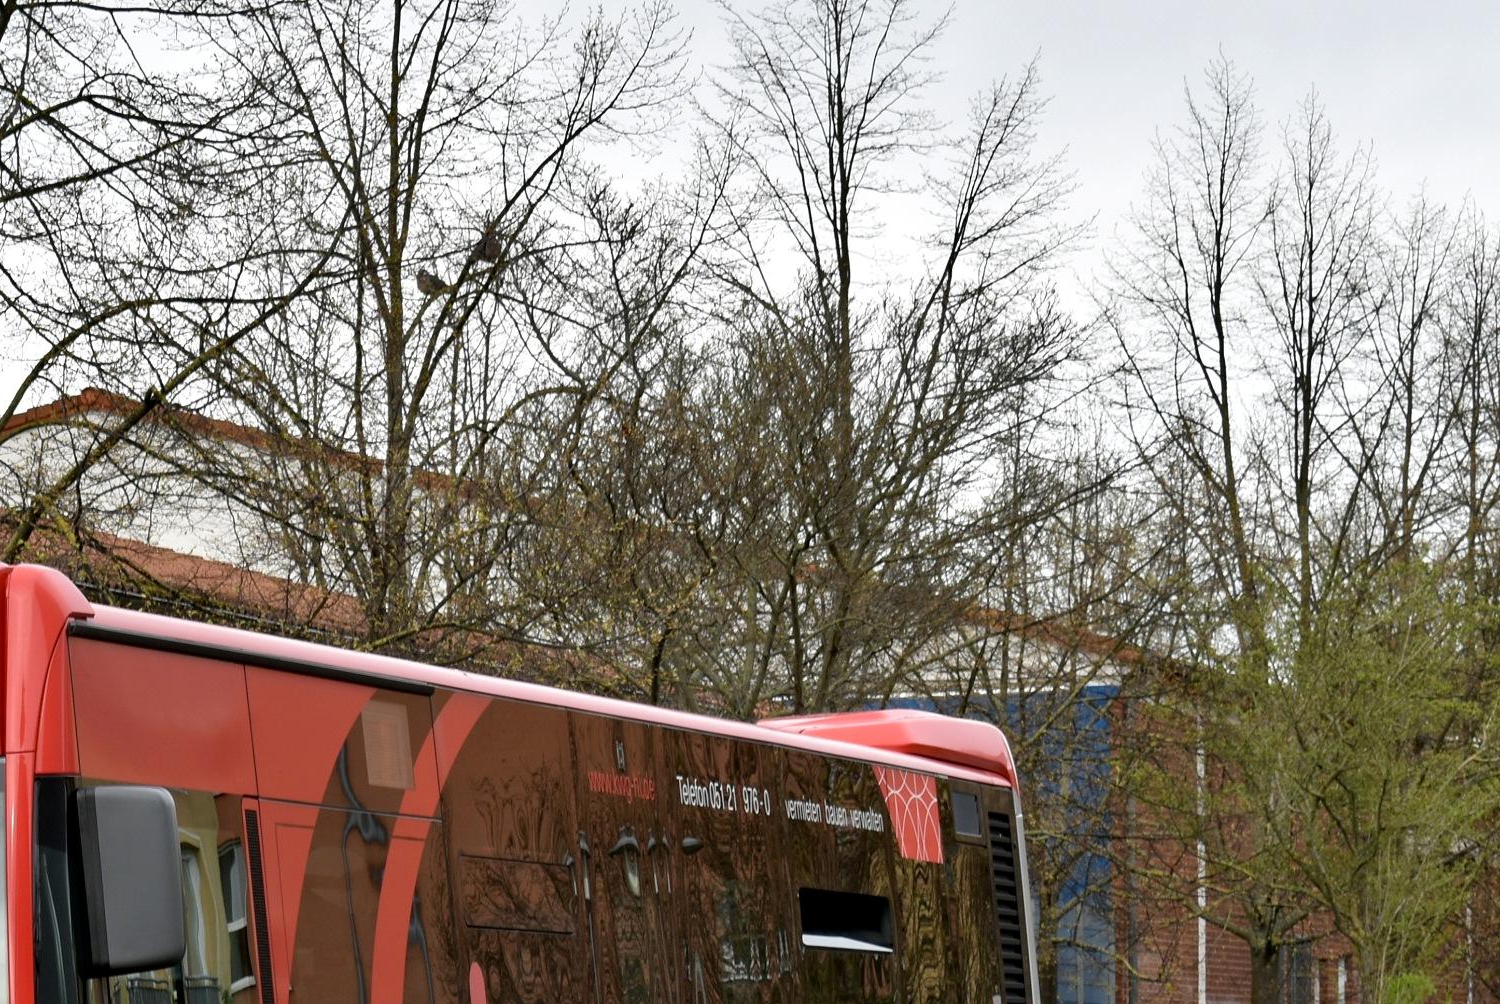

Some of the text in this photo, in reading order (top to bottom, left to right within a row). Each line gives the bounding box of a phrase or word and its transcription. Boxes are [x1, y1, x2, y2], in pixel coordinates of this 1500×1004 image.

[676, 775, 709, 808] Telefon
[785, 795, 885, 833] vermieten bauen verwalten
